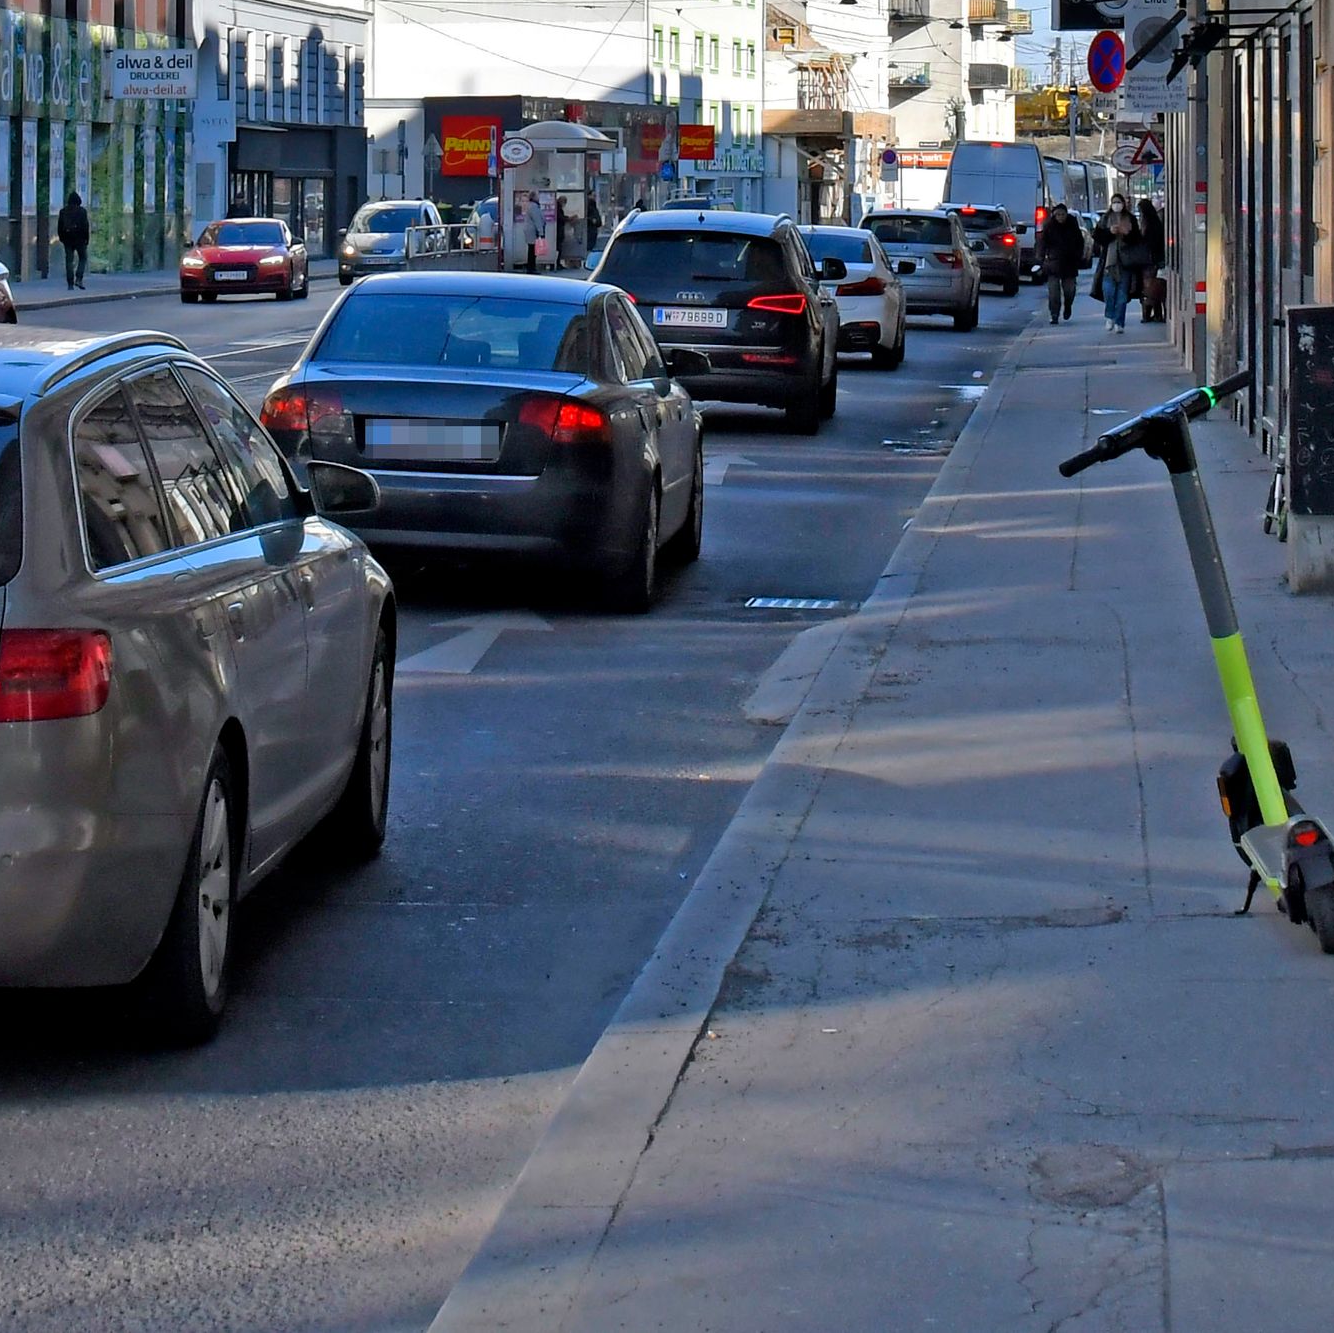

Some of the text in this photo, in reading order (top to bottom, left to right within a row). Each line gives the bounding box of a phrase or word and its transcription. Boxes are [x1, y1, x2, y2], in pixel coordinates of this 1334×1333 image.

[116, 54, 193, 69] alwa & deil
[130, 71, 180, 80] DRUCKEREI
[122, 84, 188, 96] alwa-deil.at
[665, 310, 672, 322] W
